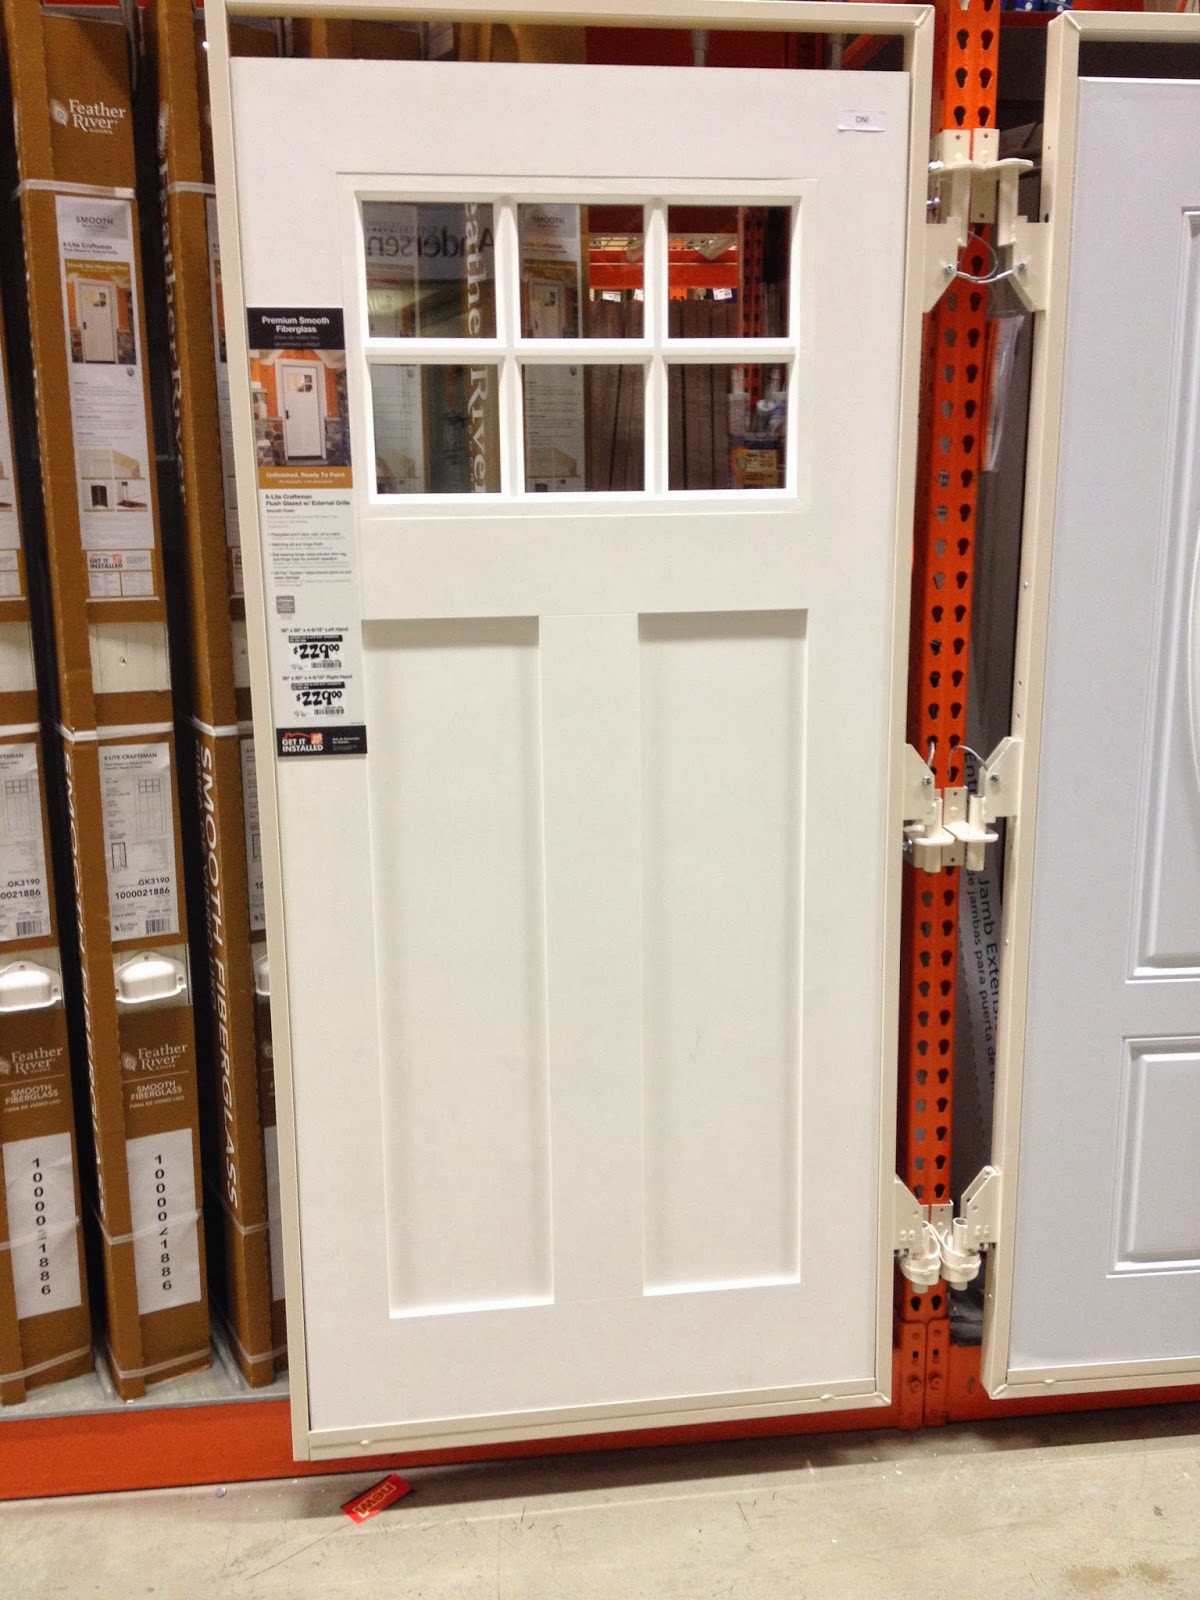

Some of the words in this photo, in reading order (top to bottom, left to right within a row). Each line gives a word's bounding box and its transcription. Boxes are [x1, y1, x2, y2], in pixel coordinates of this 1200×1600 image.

[69, 99, 126, 119] Feather
[72, 114, 114, 132] River
[76, 216, 114, 226] SMOOTH
[262, 316, 298, 325] Premium
[299, 316, 330, 325] Smooth
[275, 325, 317, 334] Fiberglass
[282, 738, 297, 746] GET
[282, 744, 323, 753] INSTALLED
[115, 887, 170, 900] 1000021886
[978, 880, 996, 935] Jamb
[967, 890, 982, 946] jambas
[974, 950, 986, 985] para
[200, 746, 223, 946] SMOOTH
[214, 957, 239, 1210] FIBERGLASS
[979, 990, 993, 1042] puerta
[11, 1046, 63, 1062] Feather
[138, 1043, 188, 1060] Feather
[15, 1059, 53, 1075] River
[141, 1055, 178, 1071] River
[11, 1084, 52, 1097] SMOOTH
[130, 1086, 182, 1101] FIBERGLASS
[136, 1080, 176, 1093] SMOOTH
[5, 1089, 59, 1104] FIBERGLASS
